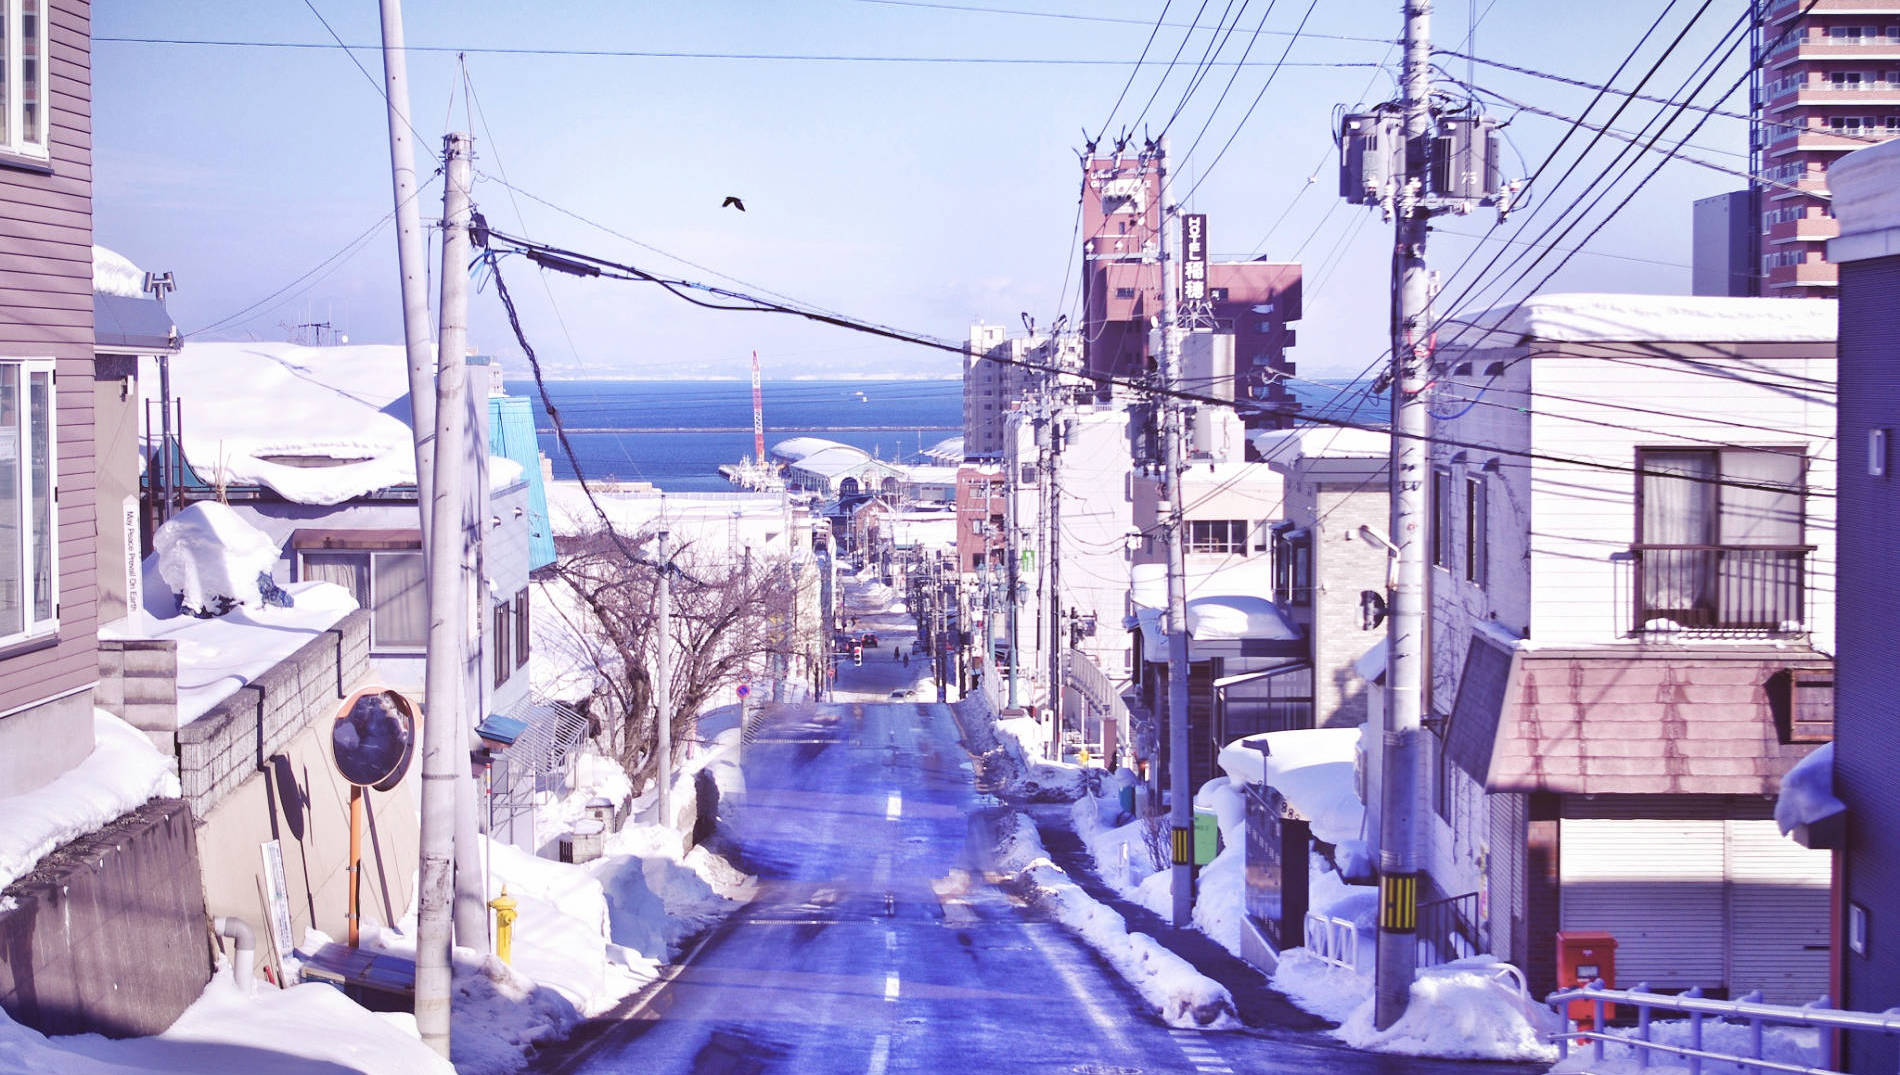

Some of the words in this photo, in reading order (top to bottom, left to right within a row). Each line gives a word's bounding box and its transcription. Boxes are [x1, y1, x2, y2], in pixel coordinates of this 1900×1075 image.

[1188, 216, 1201, 261] HOTEL
[126, 511, 134, 526] May
[127, 528, 135, 551] Peace
[128, 553, 136, 577] Prevail
[129, 579, 137, 590] On
[129, 591, 138, 612] Earth
